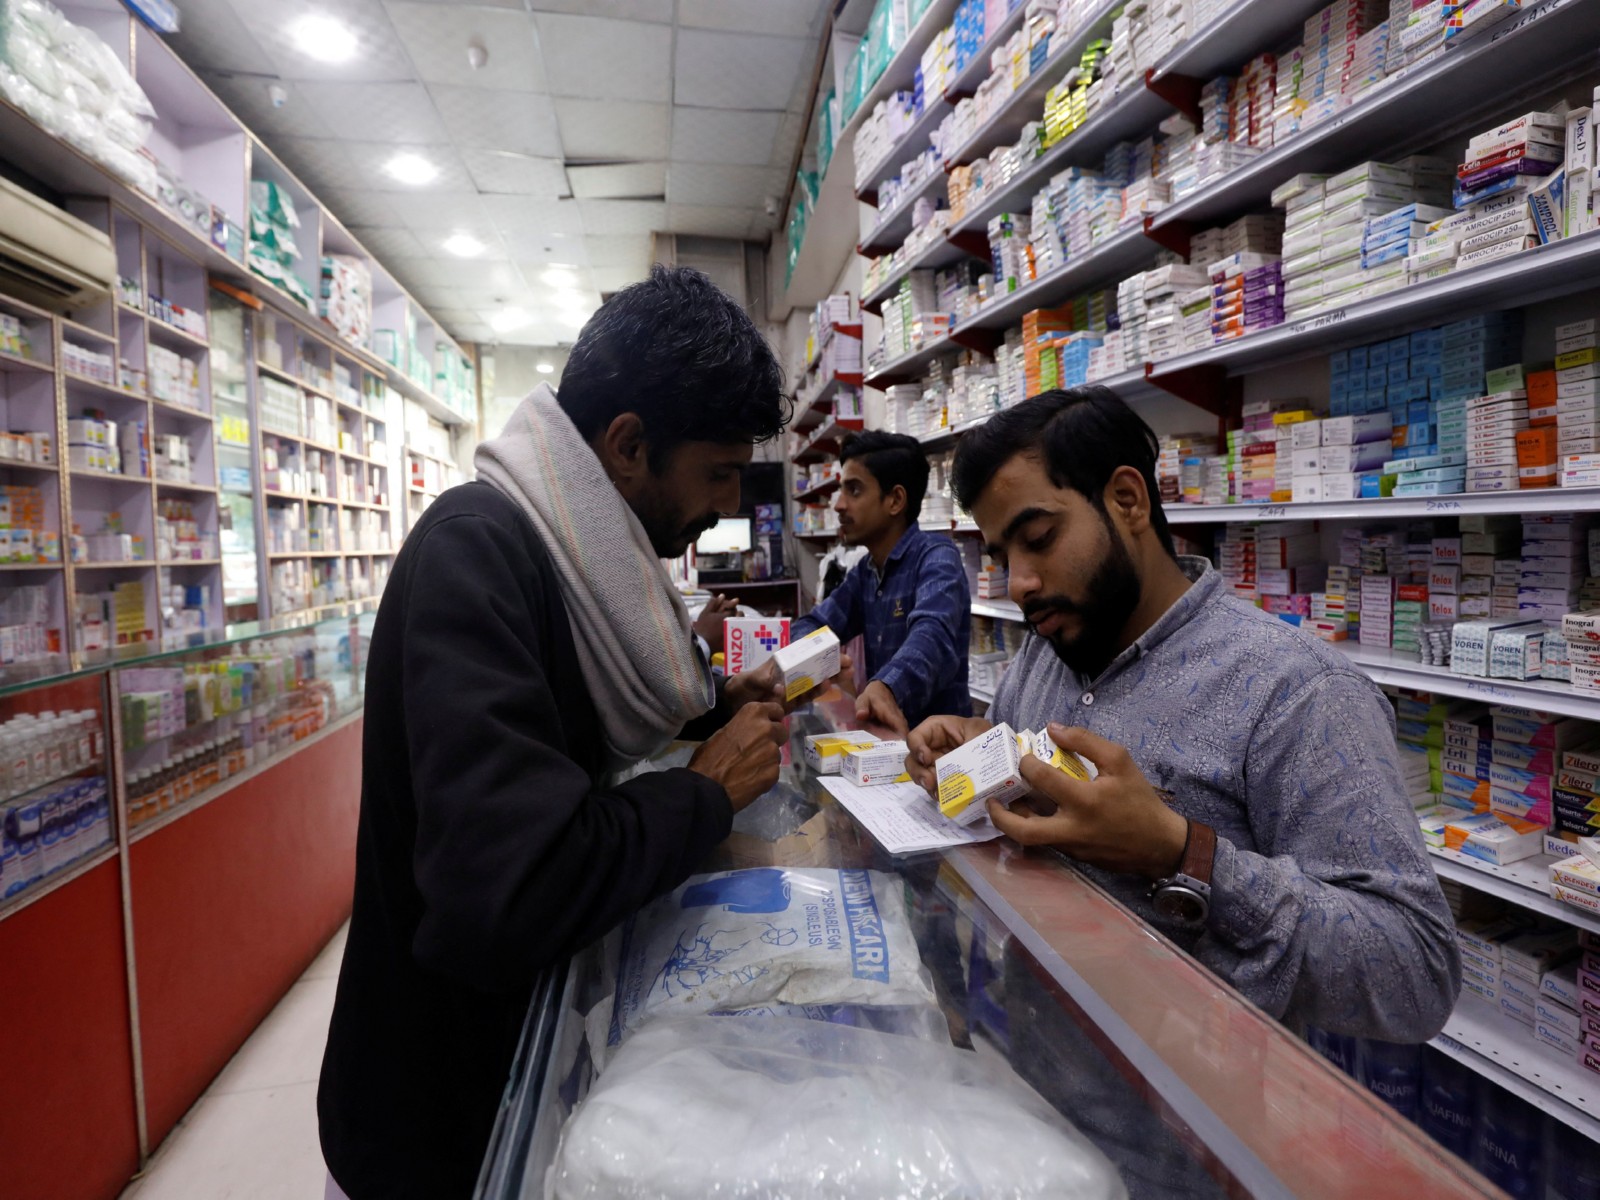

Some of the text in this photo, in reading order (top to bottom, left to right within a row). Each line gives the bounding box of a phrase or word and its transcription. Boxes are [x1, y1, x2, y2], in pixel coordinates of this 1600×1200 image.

[1577, 115, 1587, 151] Dex-D
[1534, 194, 1558, 236] XANPROL
[1465, 214, 1501, 232] AMROCIP
[1465, 230, 1501, 247] AMROCIP
[1461, 245, 1498, 263] AMROCIP
[1435, 547, 1456, 557] Telox
[1432, 574, 1452, 585] Telox
[1431, 603, 1452, 615] Telox
[1565, 618, 1595, 627] Inograf
[1454, 640, 1484, 650] VOREN
[1493, 645, 1521, 654] VOREN
[1575, 666, 1600, 677] Inogra
[1448, 735, 1467, 747] Erli
[1447, 748, 1467, 760] Erli
[1446, 762, 1466, 774] Erli
[1565, 755, 1599, 771] Zilero
[1491, 771, 1518, 783] Inosita
[1561, 773, 1593, 790] Zilero
[1492, 796, 1519, 808] Inosita
[1562, 820, 1589, 832] Telsarta
[1456, 930, 1493, 952] Necal-D
